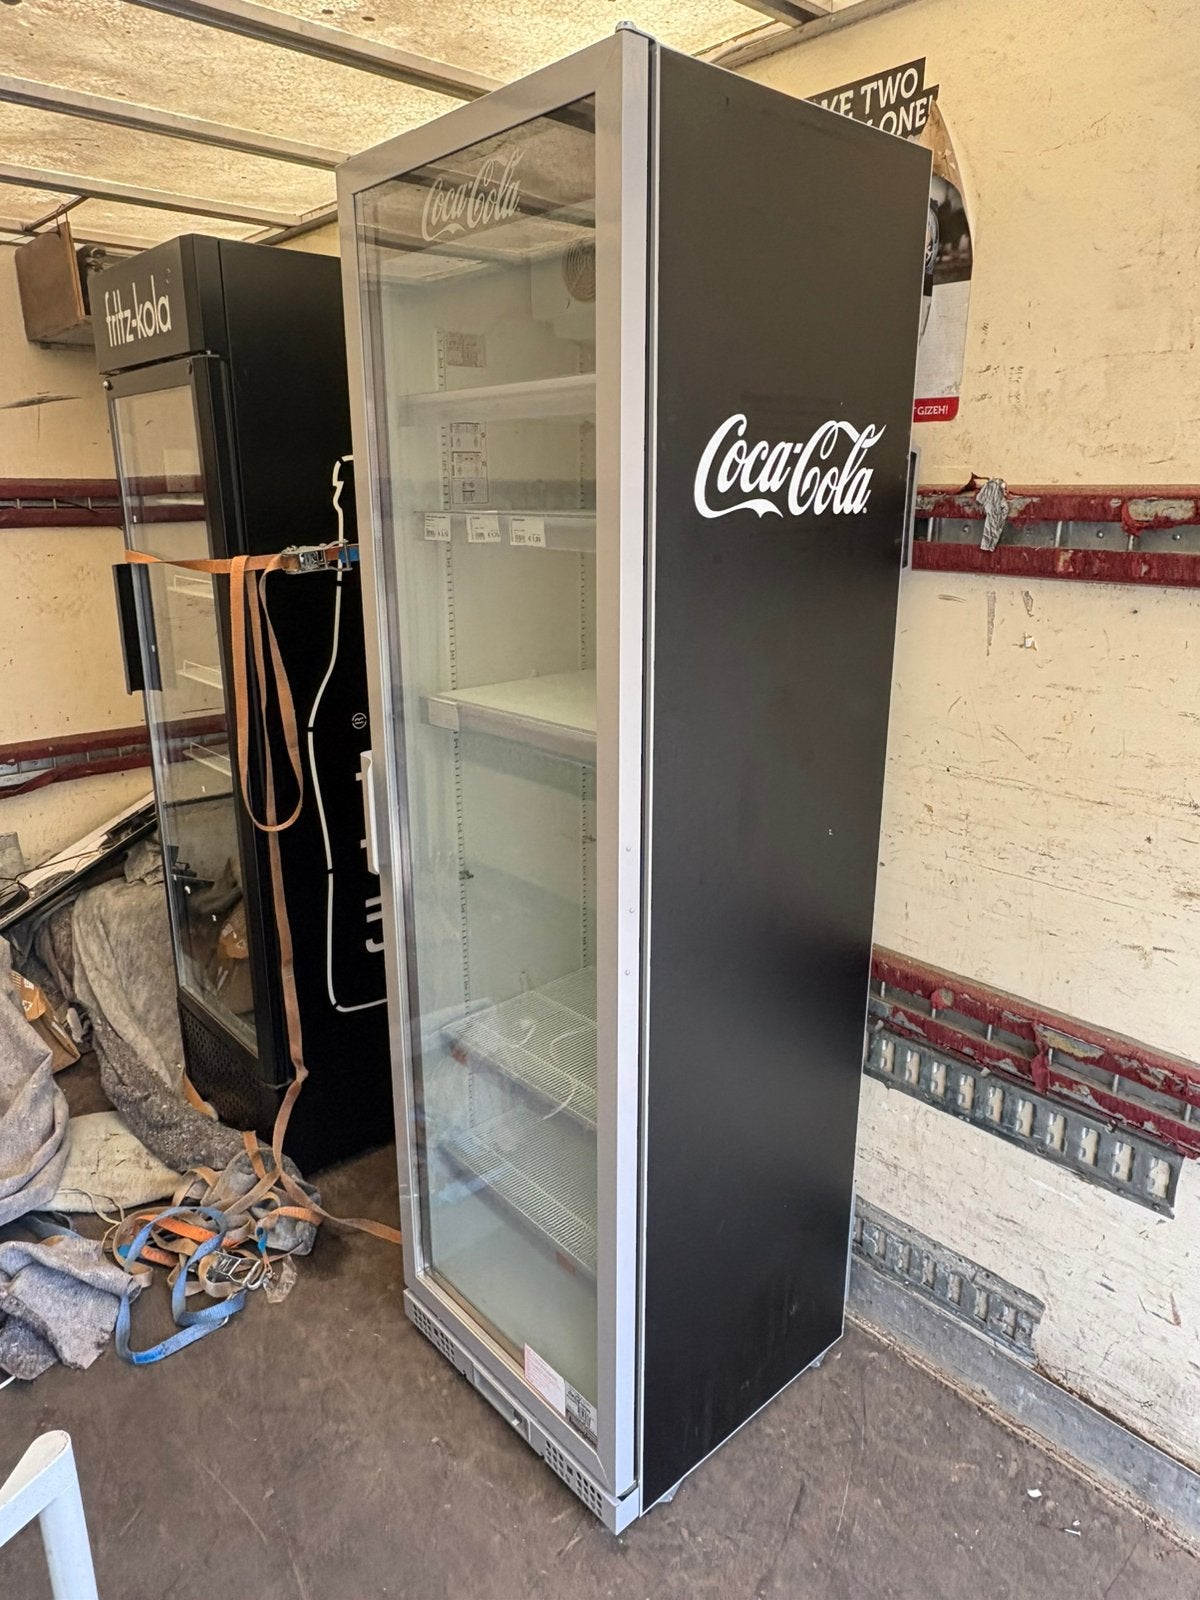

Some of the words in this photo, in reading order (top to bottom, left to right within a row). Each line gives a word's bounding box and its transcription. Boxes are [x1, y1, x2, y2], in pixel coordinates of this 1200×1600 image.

[860, 67, 919, 115] TWO
[421, 148, 526, 242] Coca-Cola
[104, 274, 172, 348] fritz-kola
[693, 413, 887, 519] Coca-Cola
